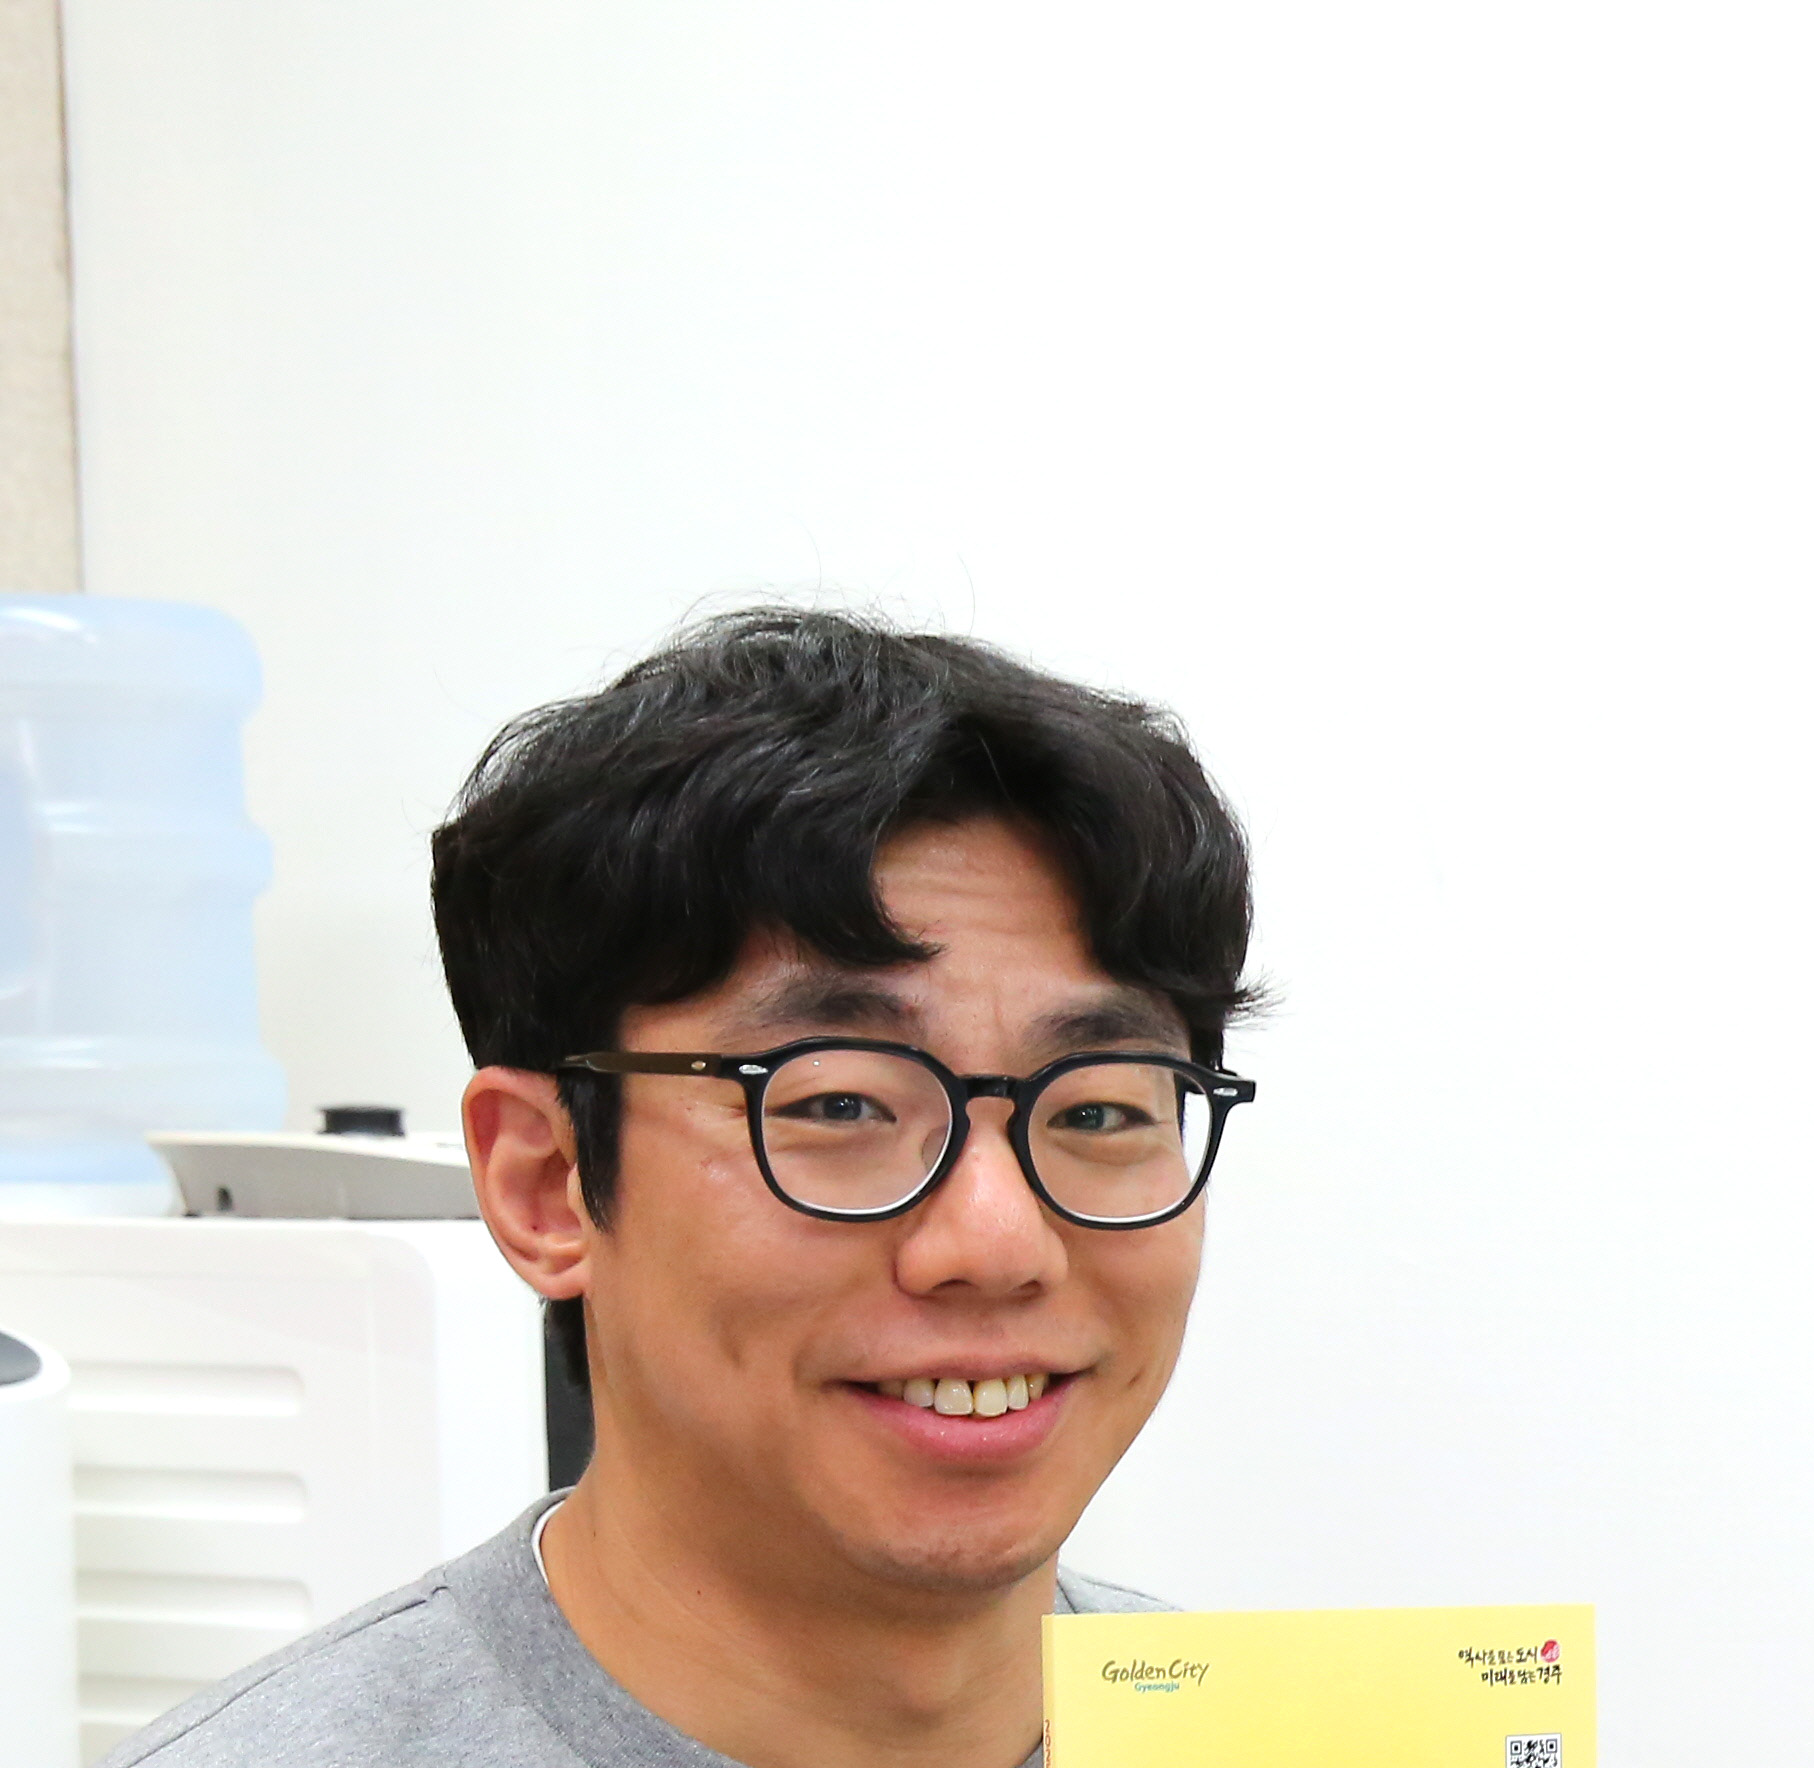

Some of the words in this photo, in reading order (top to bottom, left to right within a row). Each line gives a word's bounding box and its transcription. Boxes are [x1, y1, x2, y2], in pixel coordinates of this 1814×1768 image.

[1101, 1658, 1167, 1684] Golden
[1168, 1658, 1210, 1687] City
[1537, 1664, 1562, 1685] 경주
